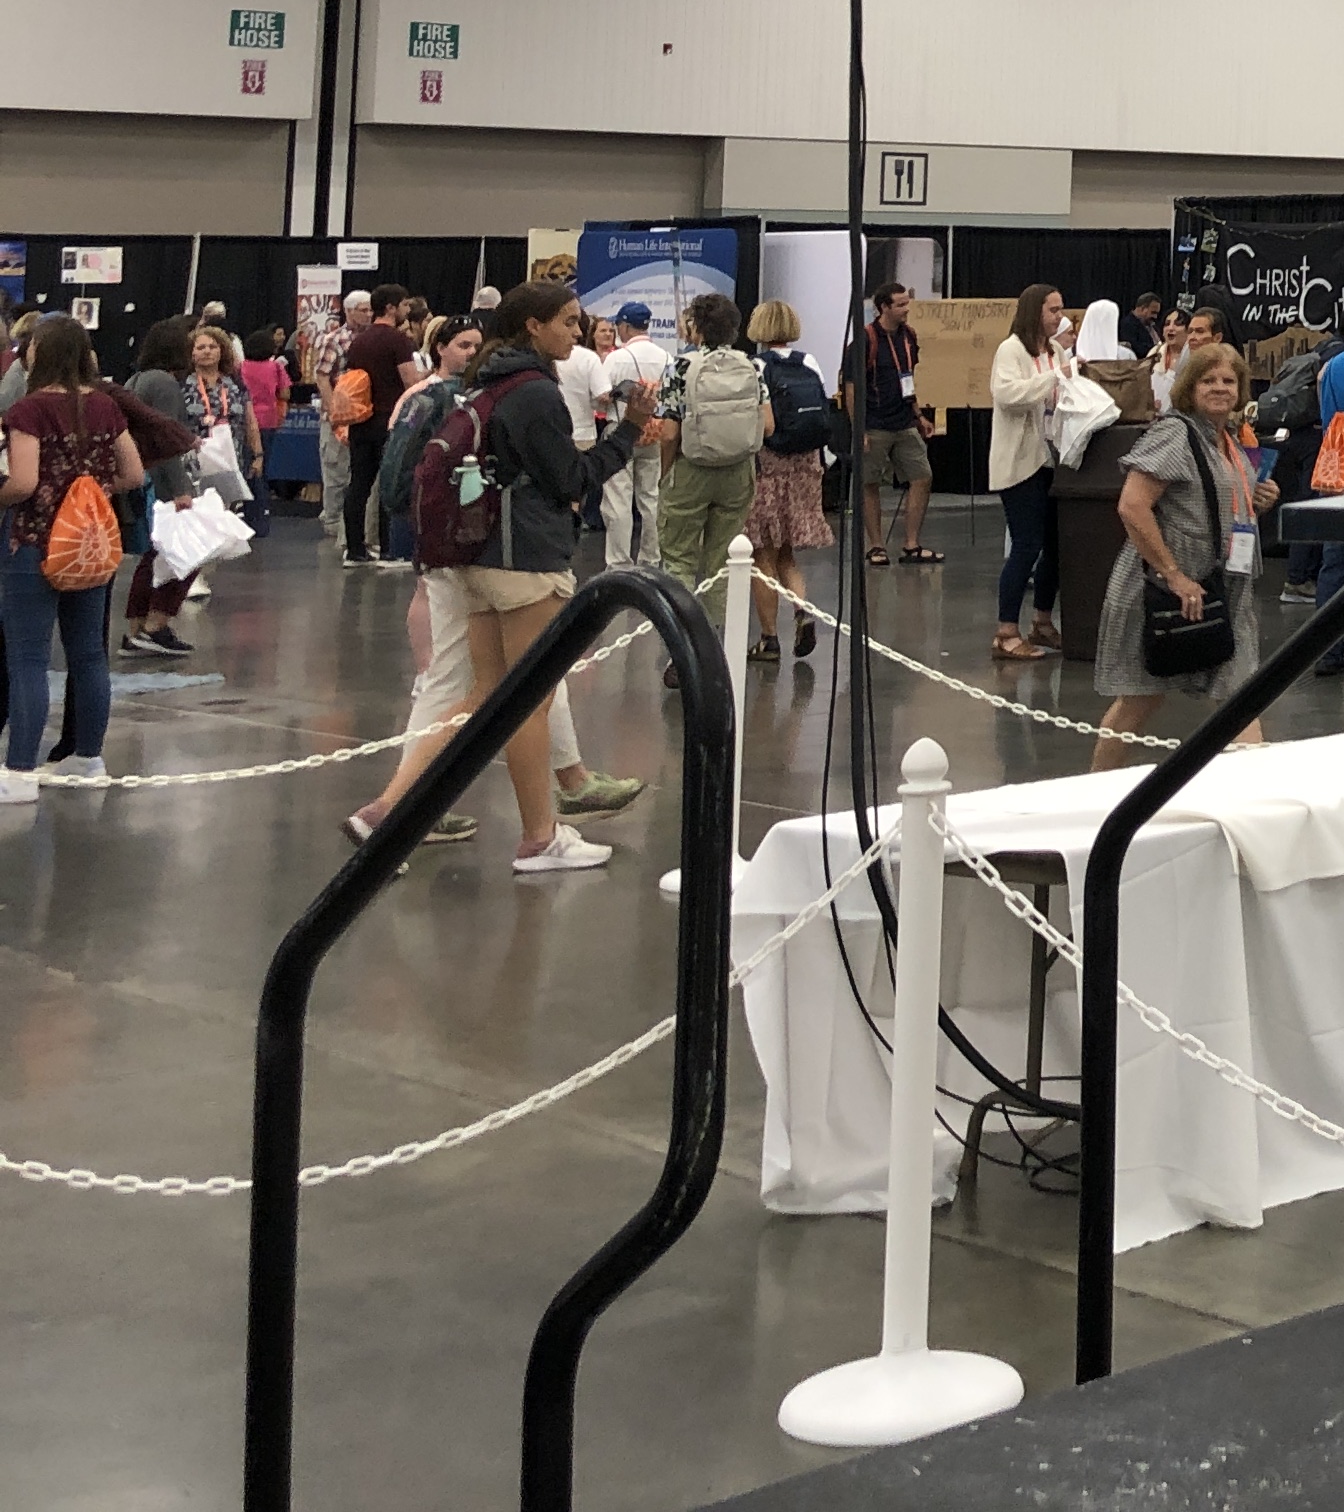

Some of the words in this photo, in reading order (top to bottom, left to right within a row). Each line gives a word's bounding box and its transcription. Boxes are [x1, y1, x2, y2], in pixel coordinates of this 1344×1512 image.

[239, 10, 277, 30] FIRE
[233, 29, 280, 48] HOSE
[418, 22, 451, 41] FIRE
[412, 40, 455, 59] HOSE
[619, 239, 644, 251] Human
[645, 239, 658, 251] Life
[915, 302, 957, 319] STREET
[1242, 303, 1263, 322] IN
[1268, 303, 1299, 325] THE
